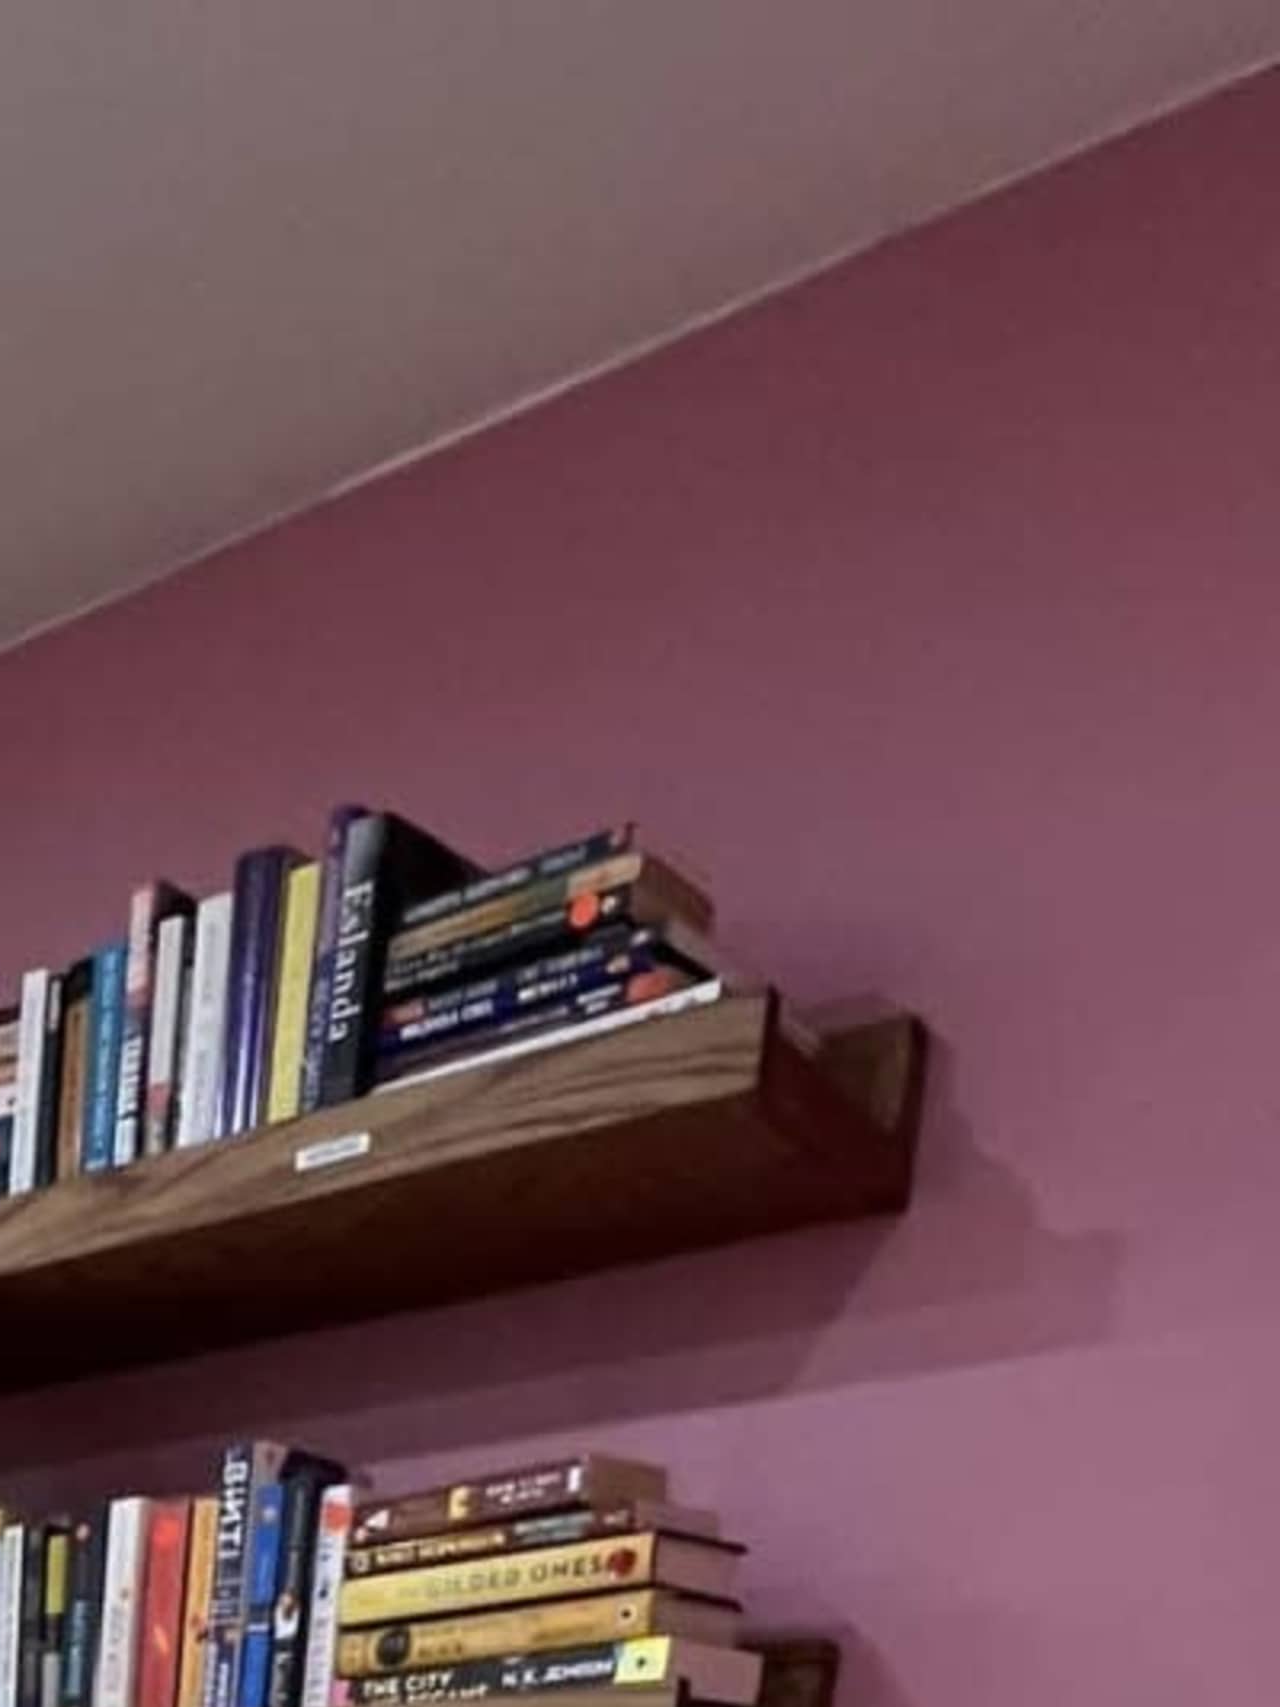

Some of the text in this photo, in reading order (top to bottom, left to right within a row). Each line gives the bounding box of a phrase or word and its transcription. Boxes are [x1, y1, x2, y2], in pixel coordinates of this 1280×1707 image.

[327, 880, 375, 1042] Eslanda
[425, 1567, 520, 1599] GILDED
[529, 1554, 602, 1584] ONES
[362, 1669, 455, 1698] THE CITY
